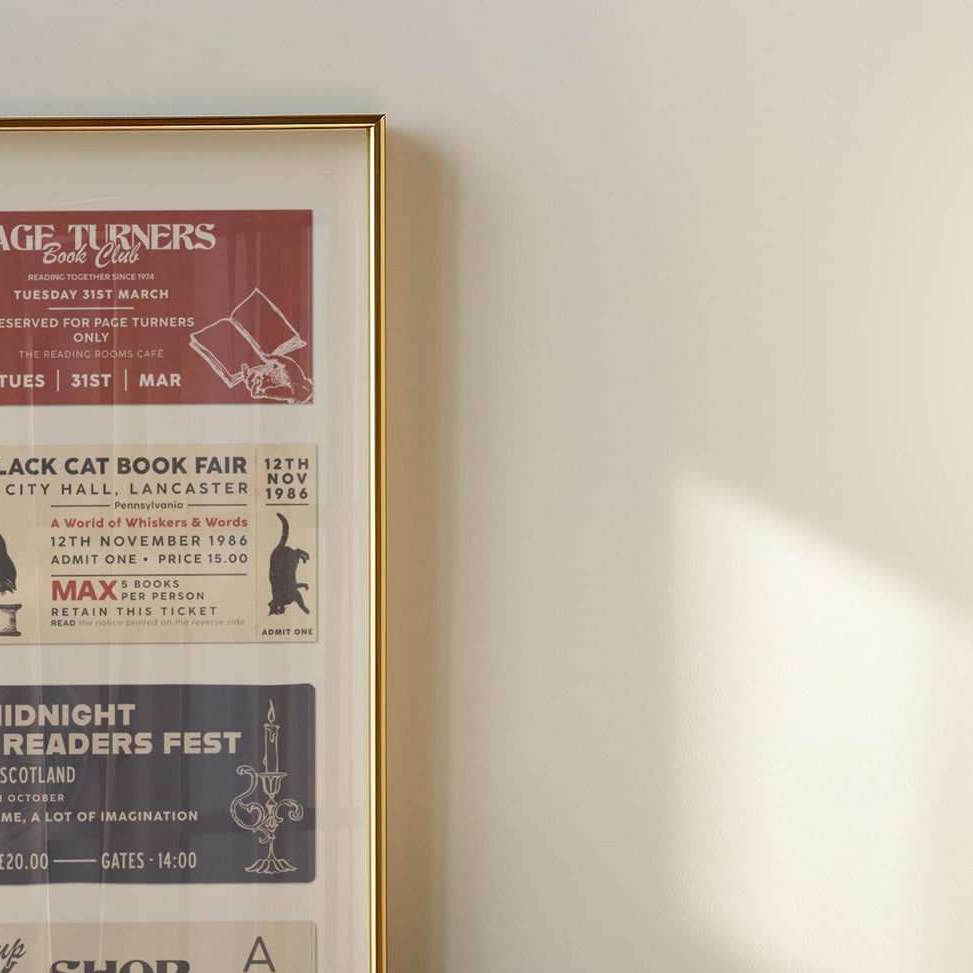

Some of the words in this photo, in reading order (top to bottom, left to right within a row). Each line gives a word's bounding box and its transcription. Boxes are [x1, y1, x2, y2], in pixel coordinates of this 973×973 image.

[68, 223, 216, 251] TURNERS
[42, 242, 87, 265] Book
[95, 242, 139, 268] Club
[14, 289, 77, 300] TUESDAY
[82, 289, 113, 299] 31ST
[118, 289, 169, 299] MARCH
[63, 318, 90, 328] FOR
[94, 317, 128, 328] PAGE
[131, 317, 194, 327] TURNERS
[73, 332, 109, 343] ONLY
[95, 350, 133, 358] ROOMS
[137, 349, 163, 358] CAFÉ
[71, 374, 112, 387] 31ST
[139, 374, 181, 387] MAR
[64, 458, 110, 475] CAT
[118, 457, 187, 475] BOOK
[196, 457, 247, 474] FAIR
[264, 458, 309, 470] 12TH
[268, 473, 308, 484] NOV
[5, 484, 50, 496] CITY
[61, 483, 120, 497] HALL,
[130, 482, 248, 495] LANCASTER
[266, 488, 309, 499] 1986
[115, 500, 184, 511] Pennsylvania
[51, 518, 59, 529] A
[63, 517, 104, 529] World
[108, 517, 121, 529] of
[126, 517, 187, 528] Whiskers
[191, 517, 201, 528] &
[205, 516, 248, 528] Words
[51, 536, 91, 548] 12TH
[101, 536, 201, 547] NOVEMBER
[209, 535, 248, 546] 1986
[51, 554, 101, 565] ADMIT
[105, 554, 137, 565] ONE
[158, 553, 203, 564] PRICE
[208, 553, 248, 564] 15.00
[51, 580, 119, 601] MAX
[121, 580, 127, 589] 5
[134, 580, 180, 589] BOOKS
[121, 592, 146, 601] PER
[152, 591, 205, 601] PERSON
[51, 607, 108, 617] RETAIN
[117, 607, 154, 616] THIS
[160, 606, 217, 616] TICKET
[79, 619, 94, 627] the
[96, 619, 123, 627] notice
[126, 619, 158, 628] printed
[177, 618, 189, 626] the
[228, 618, 245, 626] side
[262, 628, 291, 636] ADMIT
[3, 732, 152, 756] READERS
[164, 732, 241, 754] FEST
[0, 767, 76, 784] SCOTLAND
[7, 794, 64, 802] OCTOBER
[31, 811, 41, 822] A
[46, 811, 72, 822] LOT
[77, 811, 96, 822] OF
[101, 810, 199, 821] IMAGINATION
[101, 853, 145, 869] GATES
[158, 852, 197, 869] 14:00
[243, 936, 276, 973] A
